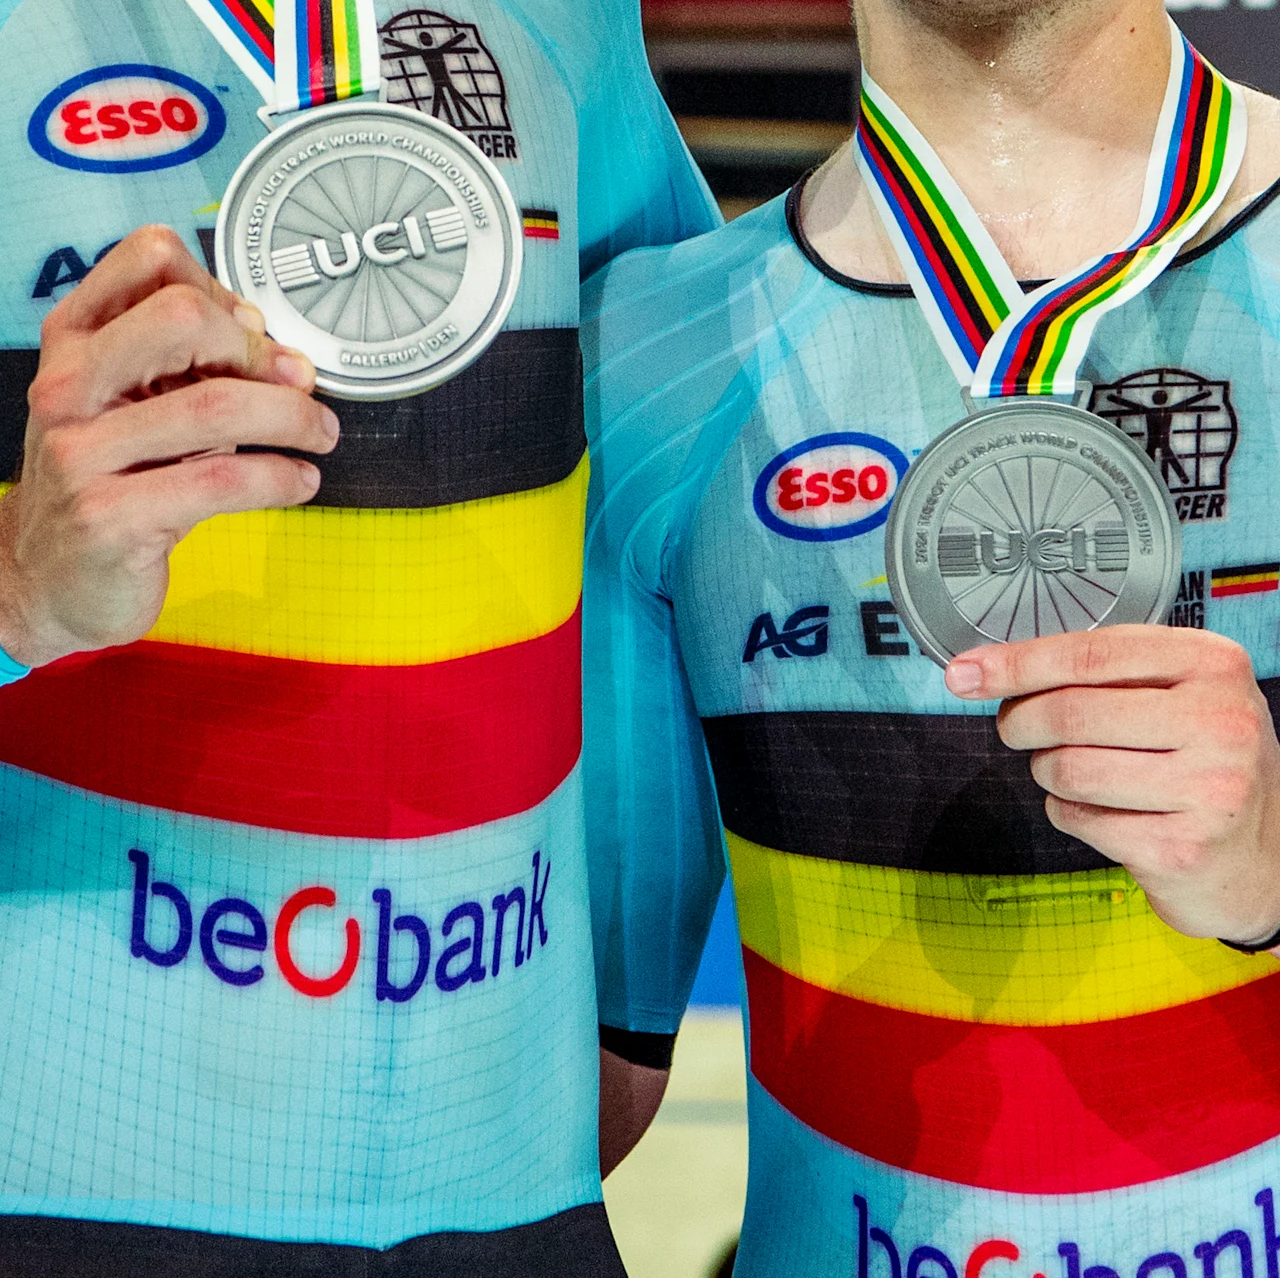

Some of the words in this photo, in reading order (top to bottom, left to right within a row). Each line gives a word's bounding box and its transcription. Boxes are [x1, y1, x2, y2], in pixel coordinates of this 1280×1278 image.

[245, 198, 271, 251] TISSOT
[264, 173, 284, 198] UCI
[281, 141, 329, 175] TRACK
[329, 131, 390, 148] WORLD
[391, 135, 489, 229] CHAMPIONSHIPS
[312, 216, 426, 280] UCI
[339, 345, 419, 366] BALLERUP
[428, 323, 458, 352] DEN
[970, 434, 1018, 461] TRACK
[1020, 430, 1078, 450] WORLD
[979, 527, 1087, 574] UCI
